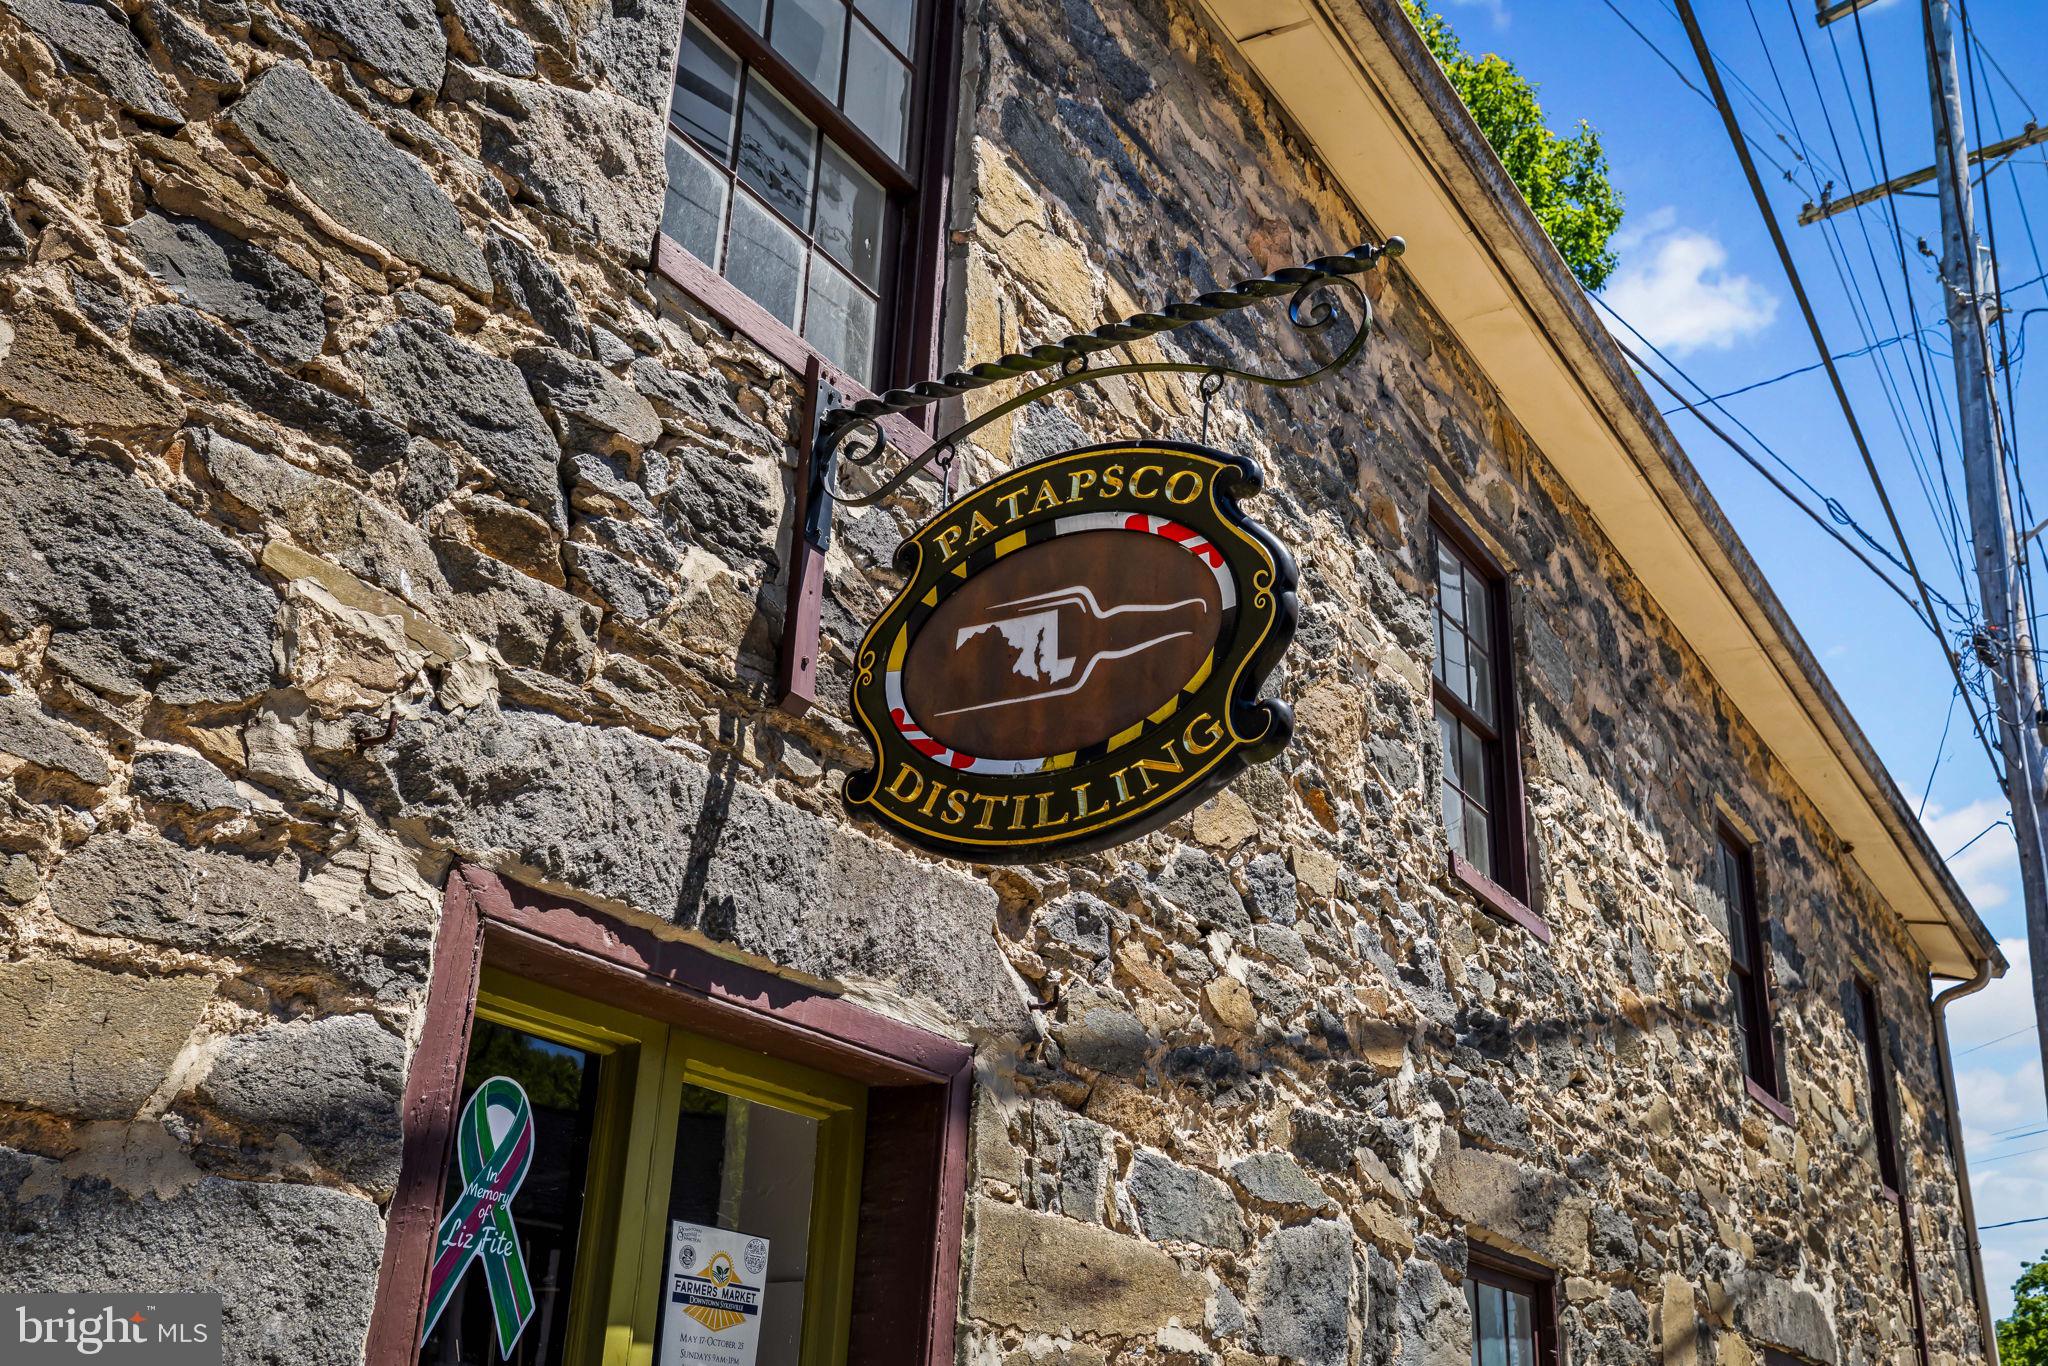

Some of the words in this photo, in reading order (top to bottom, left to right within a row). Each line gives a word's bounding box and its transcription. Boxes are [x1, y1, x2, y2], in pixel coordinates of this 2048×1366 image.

[932, 464, 1205, 564] PATAPSCO
[885, 712, 1226, 831] DISTILLING
[486, 1166, 500, 1184] In
[466, 1182, 511, 1210] Memory
[478, 1204, 492, 1224] of
[442, 1218, 474, 1249] Liz
[480, 1226, 513, 1256] Fite
[675, 1280, 718, 1298] FARMERS
[721, 1288, 757, 1304] MARKET
[680, 1333, 698, 1343] MAY
